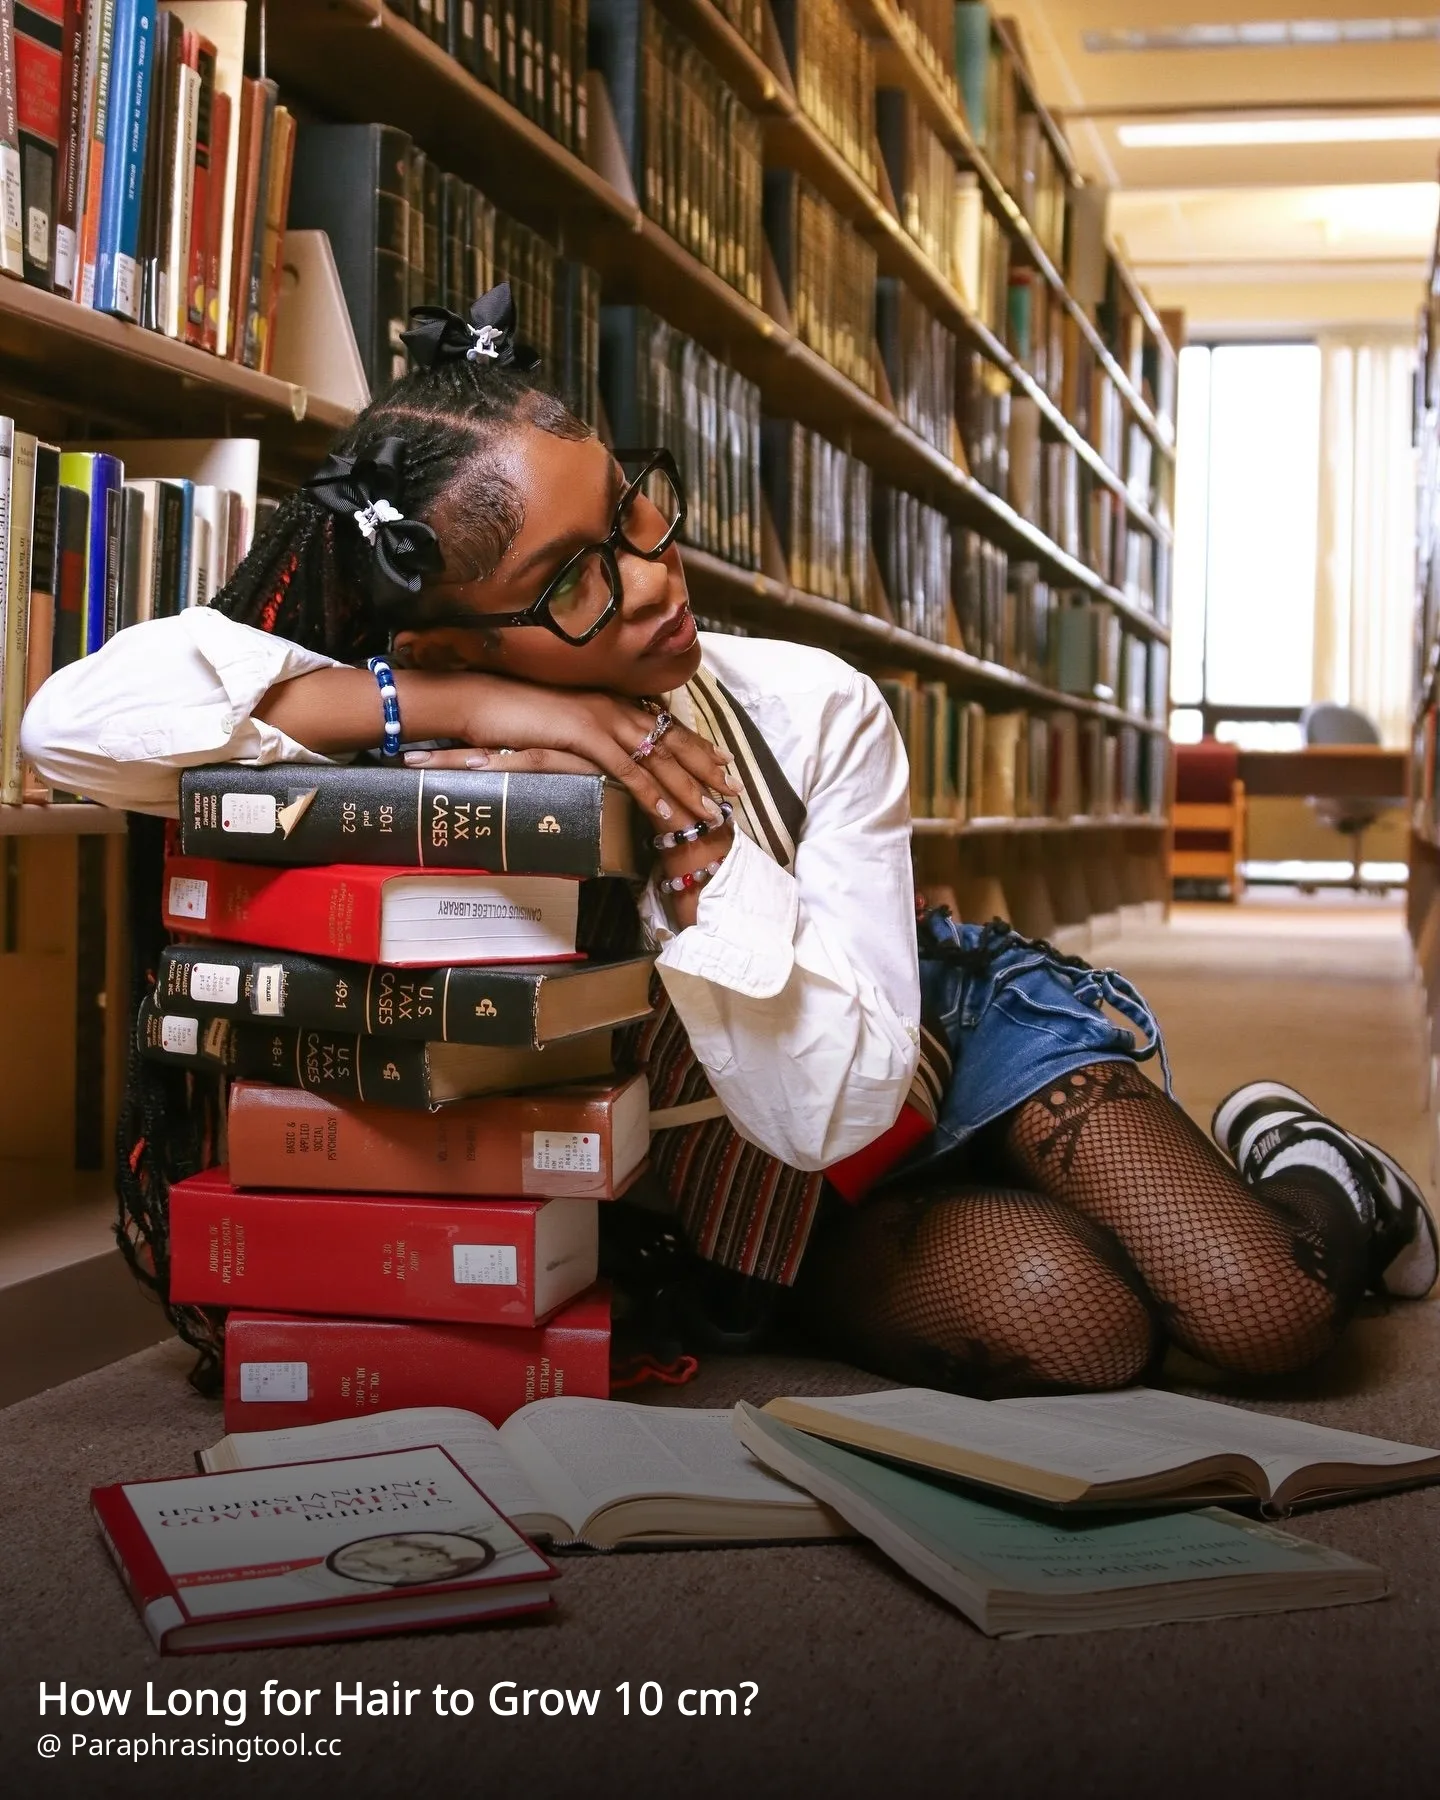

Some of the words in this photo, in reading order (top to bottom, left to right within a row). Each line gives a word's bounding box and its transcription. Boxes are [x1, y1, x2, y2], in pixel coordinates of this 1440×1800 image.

[103, 0, 114, 28] TAXES
[101, 51, 109, 60] A
[102, 30, 111, 51] ARE
[138, 35, 147, 66] FEDERAL
[2, 18, 10, 61] Reform
[6, 88, 12, 101] of
[72, 54, 80, 87] Crisis
[72, 89, 79, 101] in
[98, 62, 109, 106] WOMAN'S
[135, 71, 144, 107] TAXATION
[95, 108, 105, 138] ISSUE
[134, 108, 140, 119] IN
[131, 121, 139, 153] AMERICA
[67, 126, 77, 212] Administration
[17, 569, 25, 601] Policy
[15, 605, 24, 651] Analysis
[342, 802, 356, 833] 50-2
[363, 810, 373, 828] and
[379, 805, 393, 833] 50-1
[432, 794, 449, 847] CASES
[454, 802, 471, 840] TAX
[438, 900, 471, 917] LIBRARY
[471, 903, 508, 919] COLLEGE
[508, 905, 543, 922] CANISIUS
[181, 962, 190, 996] COMMERCE
[244, 974, 254, 997] Index
[280, 971, 290, 1009] Including
[335, 979, 348, 1009] 49-1
[378, 972, 395, 1025] CASES
[398, 983, 414, 1020] TAX
[272, 1036, 282, 1067] 48-1
[307, 1033, 321, 1084] CASES
[322, 1043, 335, 1080] TAX
[286, 1131, 295, 1154] BASIC
[300, 1123, 309, 1152] APPLIED
[313, 1126, 323, 1152] SOCIAL
[327, 1116, 337, 1161] PSYCHOLOGY
[1251, 1128, 1281, 1164] NIKE
[222, 1217, 231, 1246] SOCIAL
[209, 1238, 219, 1273] JOURNAL
[235, 1224, 245, 1277] PSYCHOLOGY
[383, 1244, 392, 1254] 30
[410, 1251, 419, 1271] 2000
[222, 1248, 231, 1284] APPLIED
[341, 1376, 350, 1397] 2000
[540, 1357, 550, 1394] APPLIED
[554, 1367, 564, 1396] JOURN
[370, 1392, 379, 1404] 30
[158, 1478, 436, 1518] UNDERSTANDING
[160, 1487, 440, 1528] GOVERNMENT
[304, 1497, 453, 1522] BUDGETS
[1041, 1561, 1170, 1578] BUDGET
